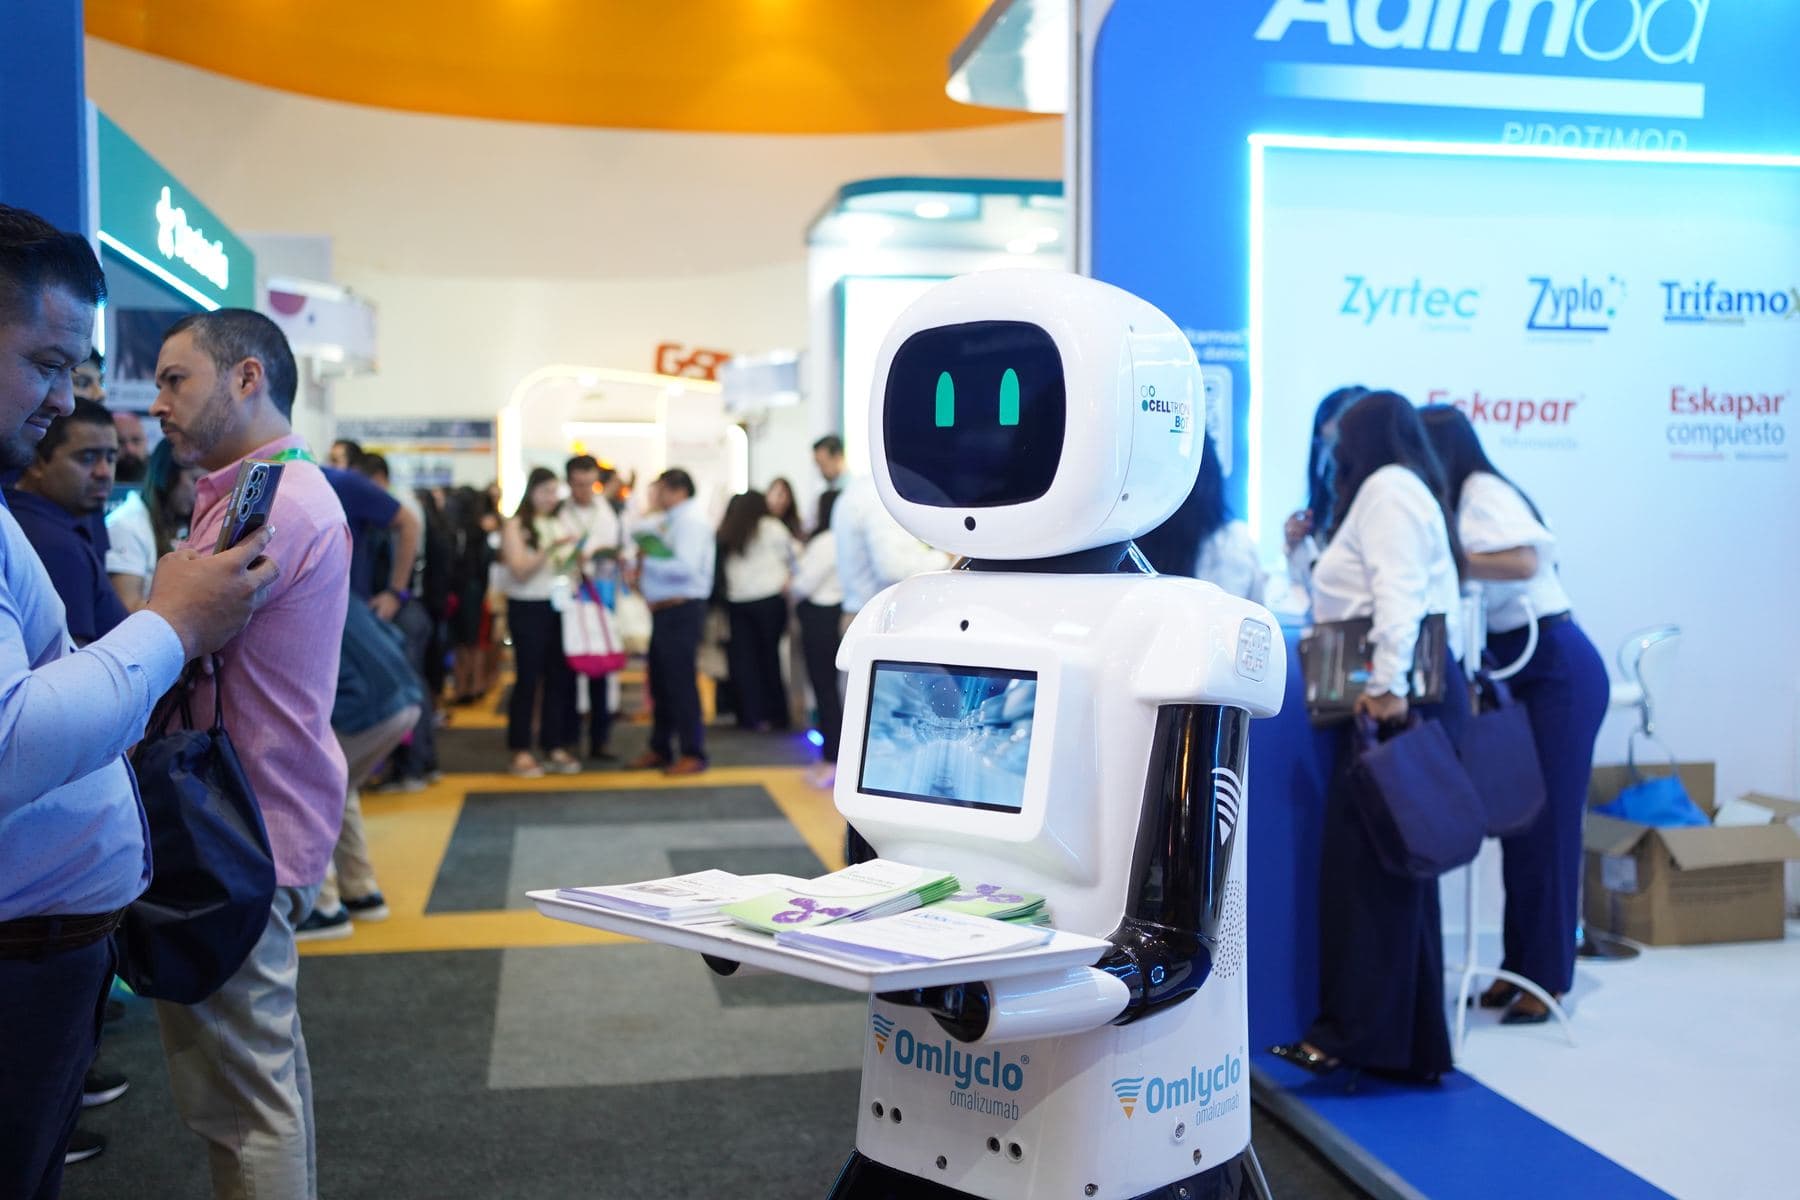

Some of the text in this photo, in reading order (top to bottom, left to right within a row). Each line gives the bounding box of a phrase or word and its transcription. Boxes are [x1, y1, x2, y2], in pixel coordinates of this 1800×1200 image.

[1340, 275, 1480, 325] Zyrtec
[1527, 277, 1604, 330] Zyplo
[1670, 385, 1784, 421] Eskapar
[1666, 422, 1786, 449] compuesto
[950, 1089, 1019, 1121] omalizumab
